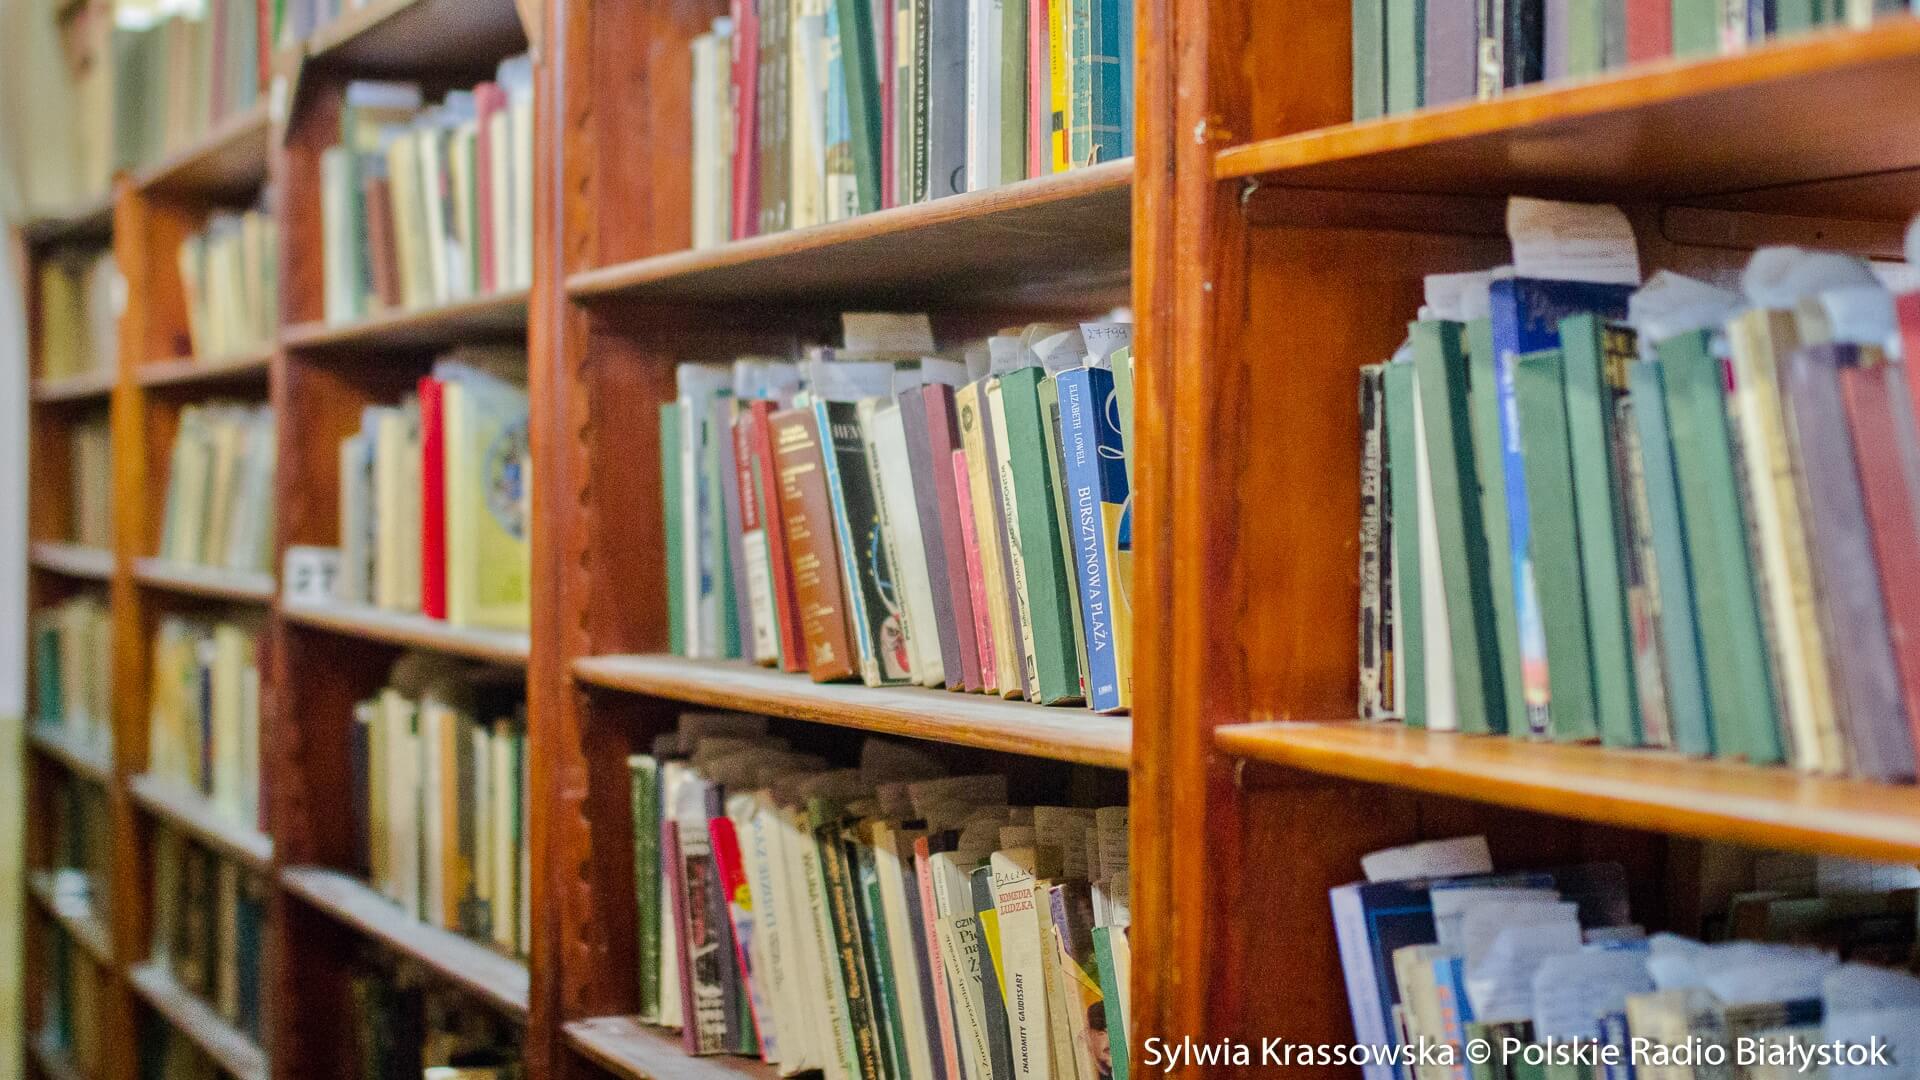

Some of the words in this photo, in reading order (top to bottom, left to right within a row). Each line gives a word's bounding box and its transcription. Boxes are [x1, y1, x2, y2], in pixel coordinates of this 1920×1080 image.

[916, 115, 925, 199] KAZIMIERZ
[1068, 382, 1082, 430] ELIZABETH
[1073, 431, 1086, 468] LOWELL
[1077, 485, 1101, 599] BURSZTYNOWA
[1090, 601, 1107, 652] PLAŻA
[998, 888, 1033, 904] KOMEDIA
[999, 900, 1034, 916] LUDZKA
[1017, 973, 1027, 1023] GAUDISSART
[1017, 1026, 1030, 1075] ZNAKOMITY
